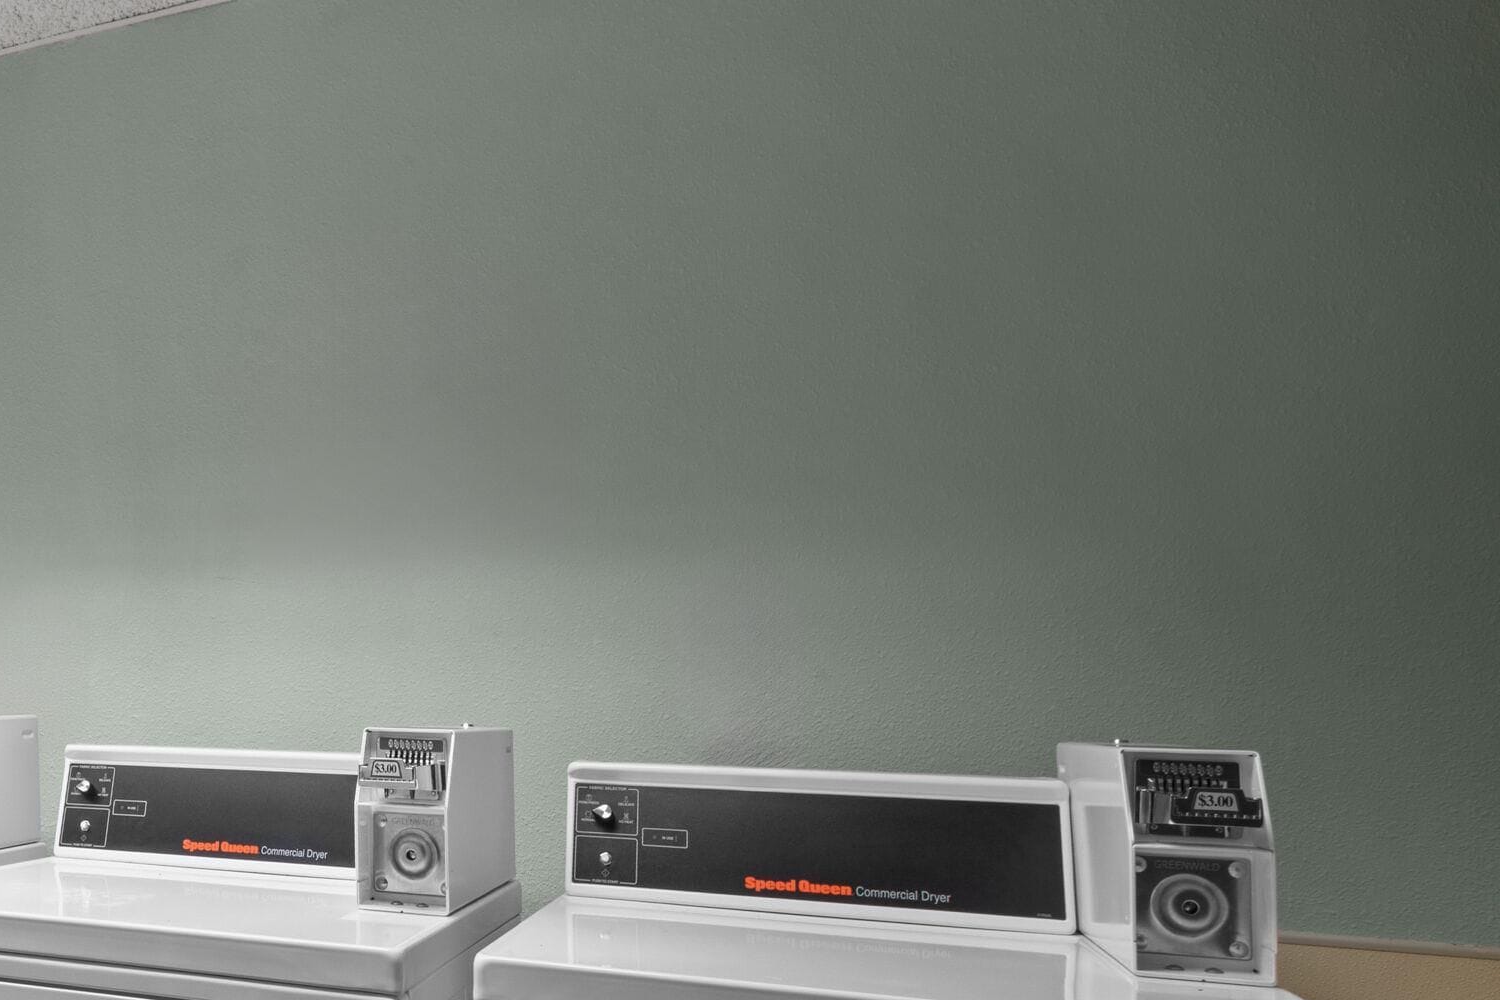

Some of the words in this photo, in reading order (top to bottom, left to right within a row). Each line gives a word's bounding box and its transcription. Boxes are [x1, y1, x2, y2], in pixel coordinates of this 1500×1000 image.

[374, 763, 398, 774] $3.00
[1197, 794, 1234, 808] $3.00
[182, 838, 220, 852] Speed
[220, 841, 259, 854] Queen
[260, 846, 305, 858] Commercial
[306, 849, 328, 860] Dryer
[1155, 859, 1221, 872] GREENWALD
[744, 876, 796, 892] Speed
[798, 879, 853, 895] Queen
[855, 886, 918, 901] Commercial
[921, 890, 951, 904] Dryer
